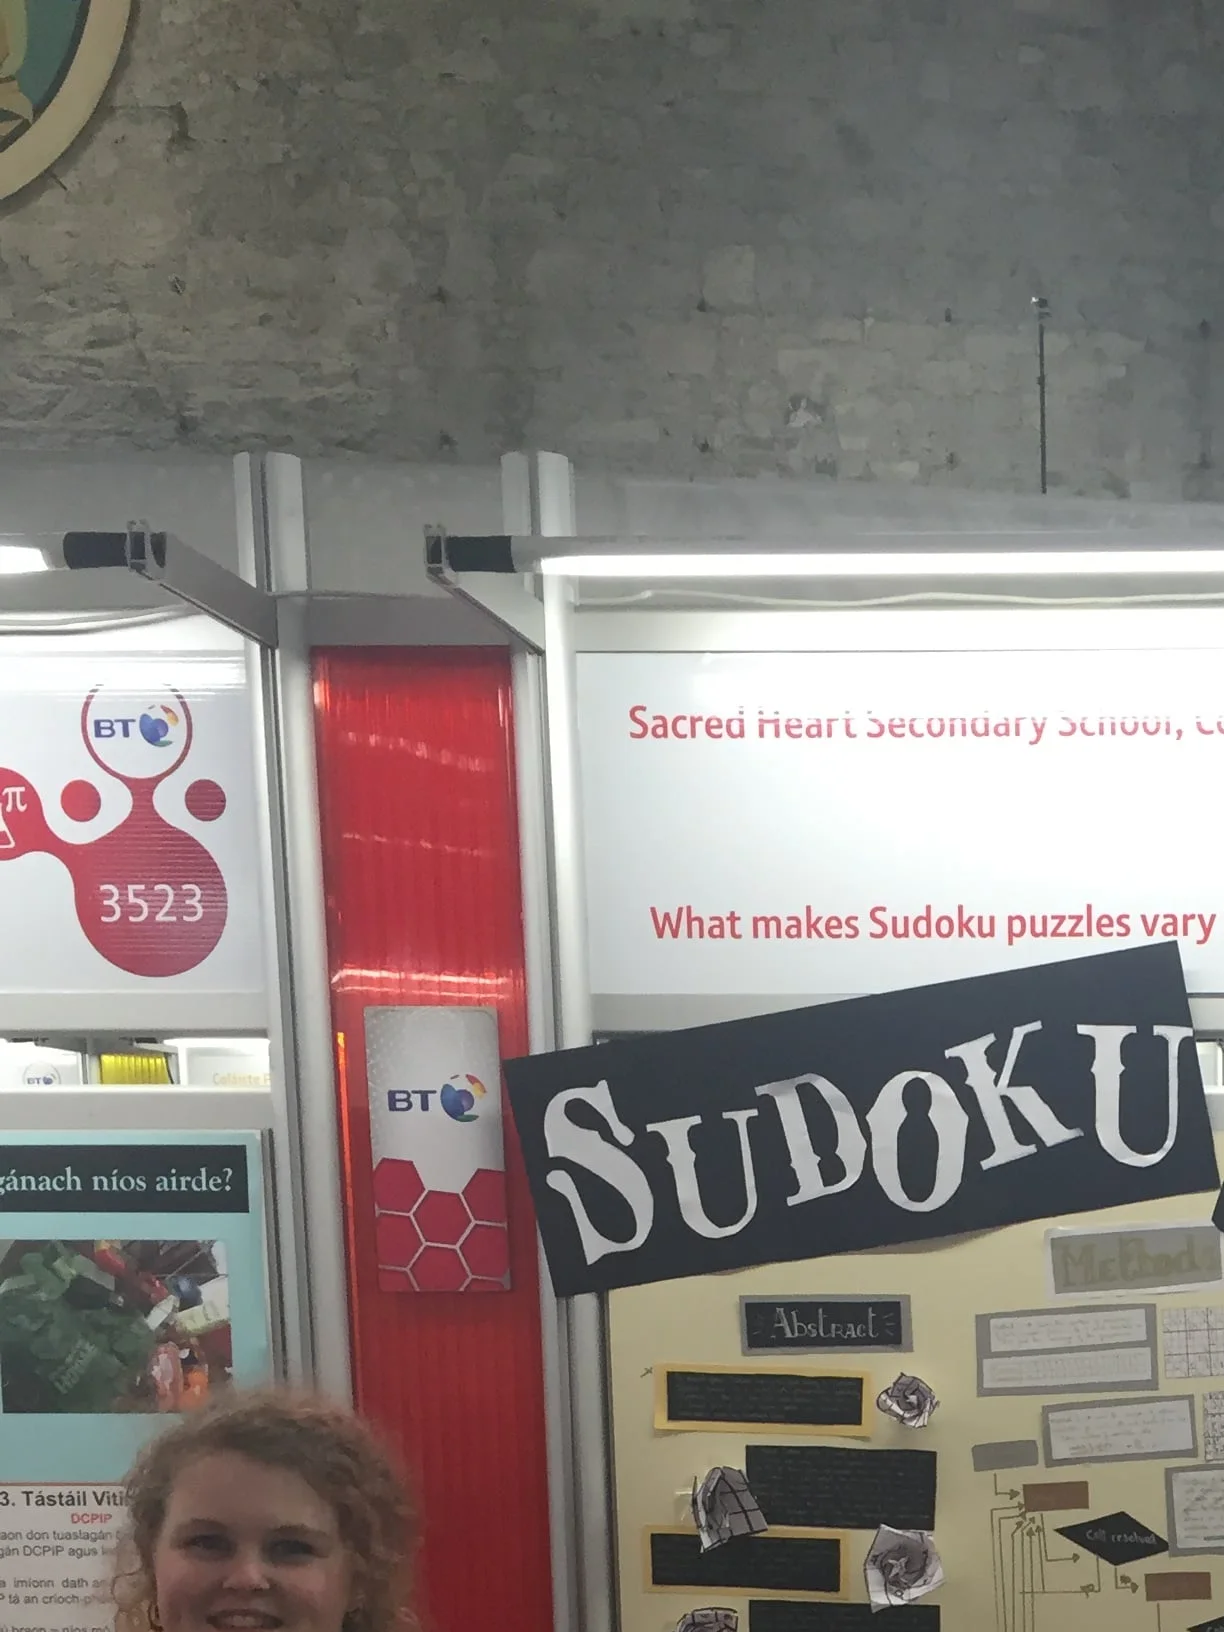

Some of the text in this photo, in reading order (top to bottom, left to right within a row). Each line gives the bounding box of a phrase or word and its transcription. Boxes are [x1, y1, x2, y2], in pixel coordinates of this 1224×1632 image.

[94, 718, 135, 739] BT
[629, 704, 745, 739] Sacred
[757, 706, 857, 739] Heart
[866, 710, 1048, 746] Secondary
[101, 884, 204, 923] 3523
[651, 906, 741, 939] What
[752, 904, 860, 939] makes
[869, 904, 996, 938] Sudoku
[1006, 903, 1131, 945] puzzles
[1140, 911, 1215, 945] vary
[388, 1090, 437, 1112] BT
[92, 1168, 147, 1191] níos
[155, 1167, 233, 1192] airde?
[22, 1490, 87, 1507] Tástáil
[93, 1490, 129, 1507] Viti
[71, 1513, 112, 1524] DCPIP
[26, 1530, 49, 1541] don
